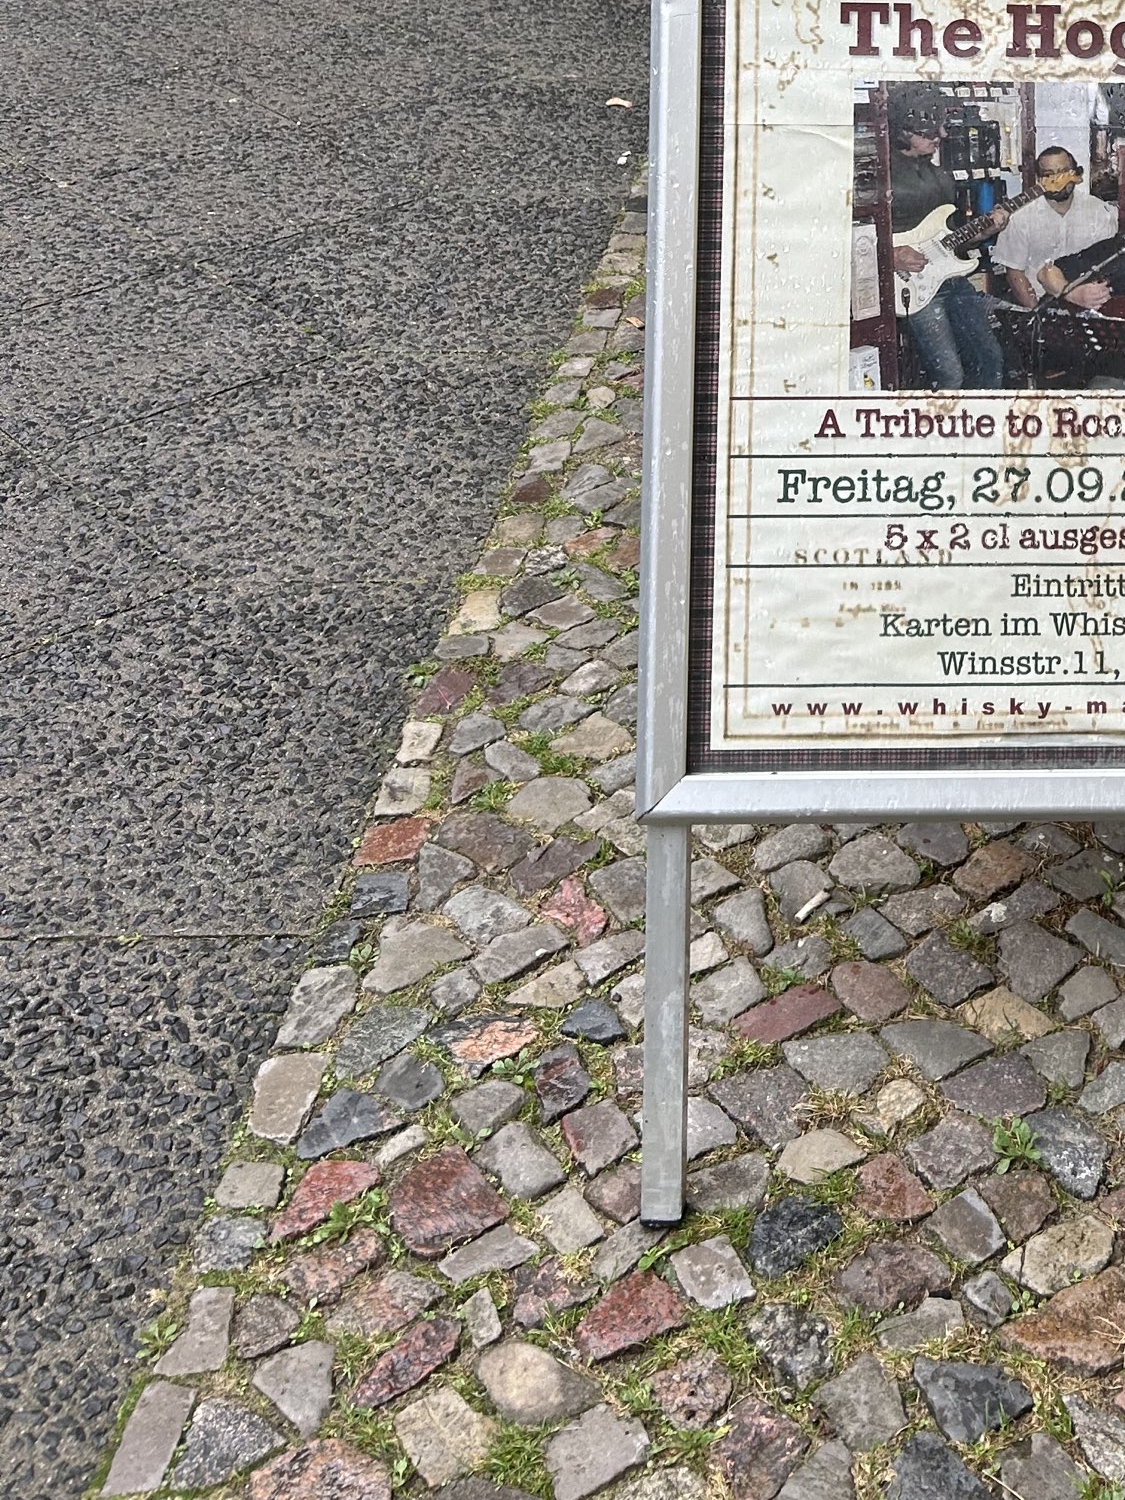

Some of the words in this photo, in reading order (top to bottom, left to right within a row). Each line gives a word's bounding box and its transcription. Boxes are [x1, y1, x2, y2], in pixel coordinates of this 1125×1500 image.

[840, 2, 983, 58] The
[814, 409, 846, 437] A
[855, 408, 996, 438] Tribute
[1005, 411, 1043, 438] to
[777, 469, 957, 510] Freitag,
[884, 523, 908, 551] 5
[916, 529, 939, 550] x
[949, 523, 971, 551] 2
[980, 523, 1010, 550] cl
[879, 613, 992, 637] Karten
[1000, 613, 1042, 636] im
[937, 650, 1121, 681] Winsstr.11,
